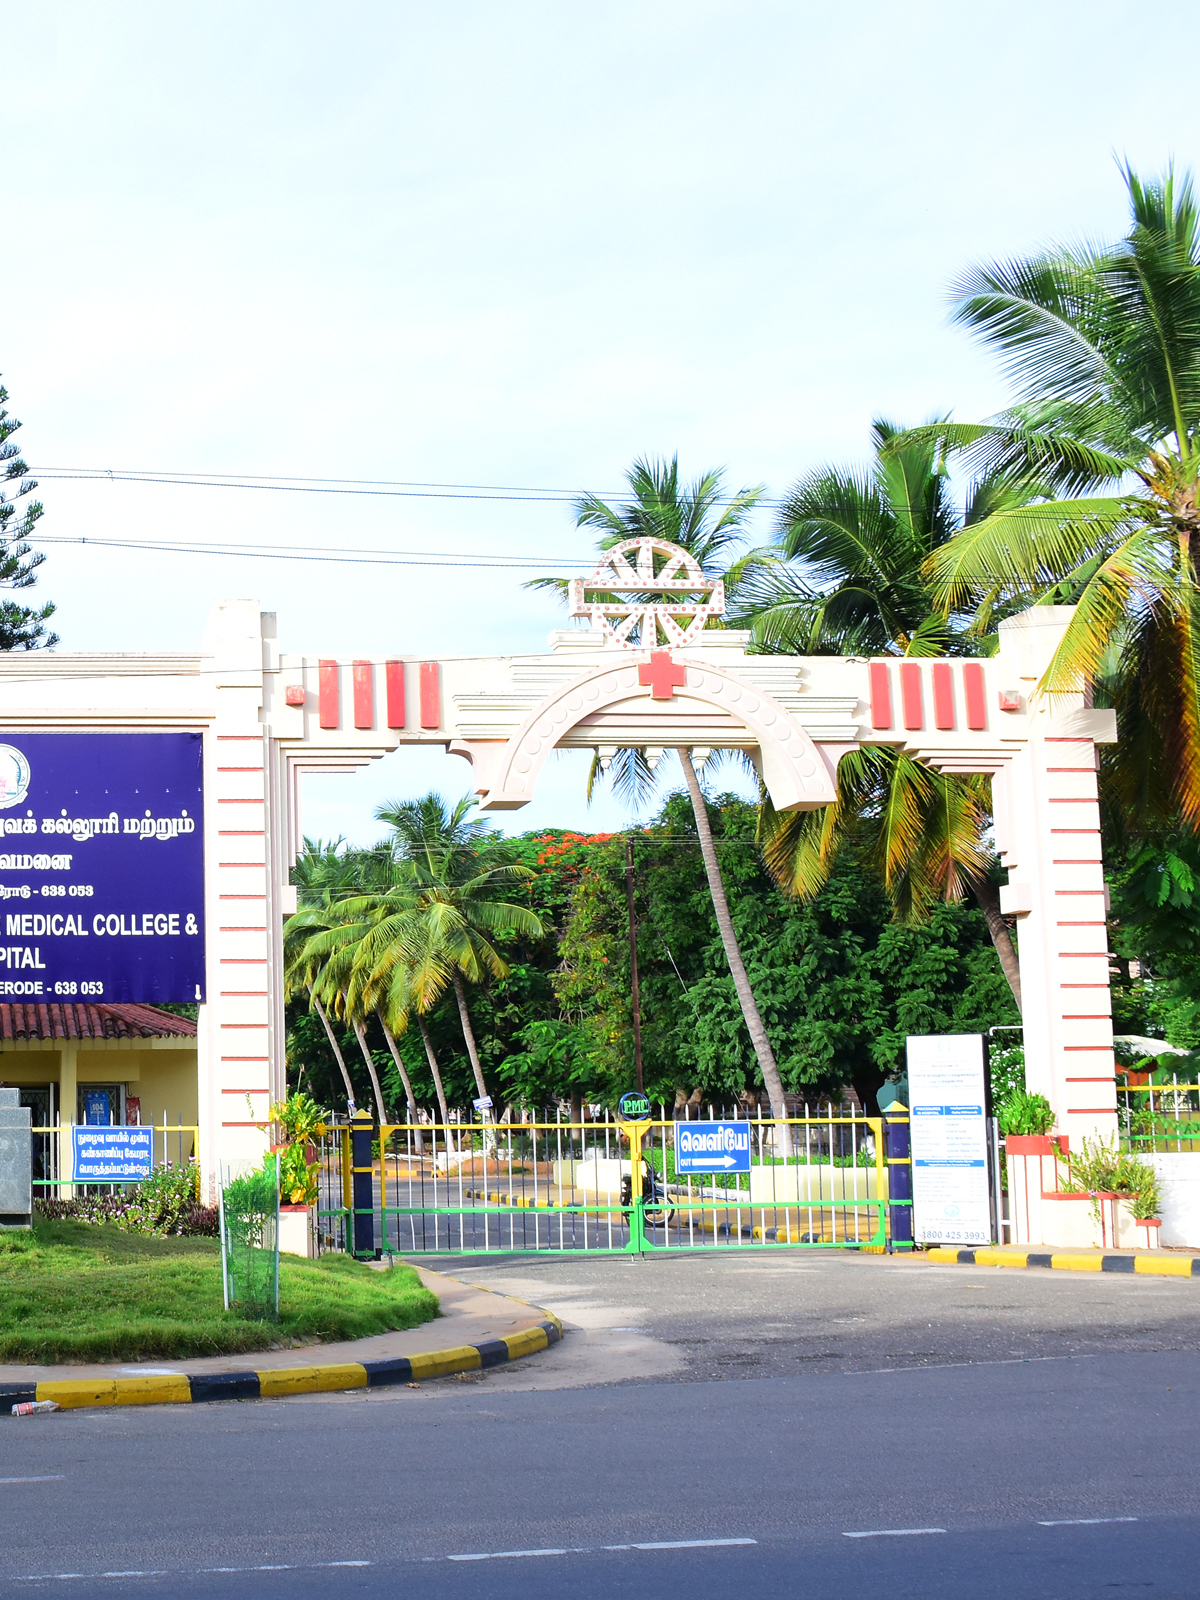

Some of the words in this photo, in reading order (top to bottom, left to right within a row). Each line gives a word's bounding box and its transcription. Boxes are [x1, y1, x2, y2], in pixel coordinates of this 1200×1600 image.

[41, 808, 120, 841] கல்லூரி
[123, 809, 195, 840] மற்றும்
[41, 885, 67, 897] 638
[69, 885, 94, 897] 053
[6, 913, 89, 936] MEDICAL
[93, 912, 180, 936] COLLEGE
[184, 912, 199, 936] &
[54, 981, 78, 995] 638
[80, 981, 104, 995] 053
[105, 1131, 129, 1143] வாயில்
[680, 1125, 748, 1153] வெளியே
[680, 1158, 692, 1167] OUT
[922, 1230, 943, 1239] 1800
[945, 1231, 962, 1239] 425
[964, 1231, 986, 1240] 3993
